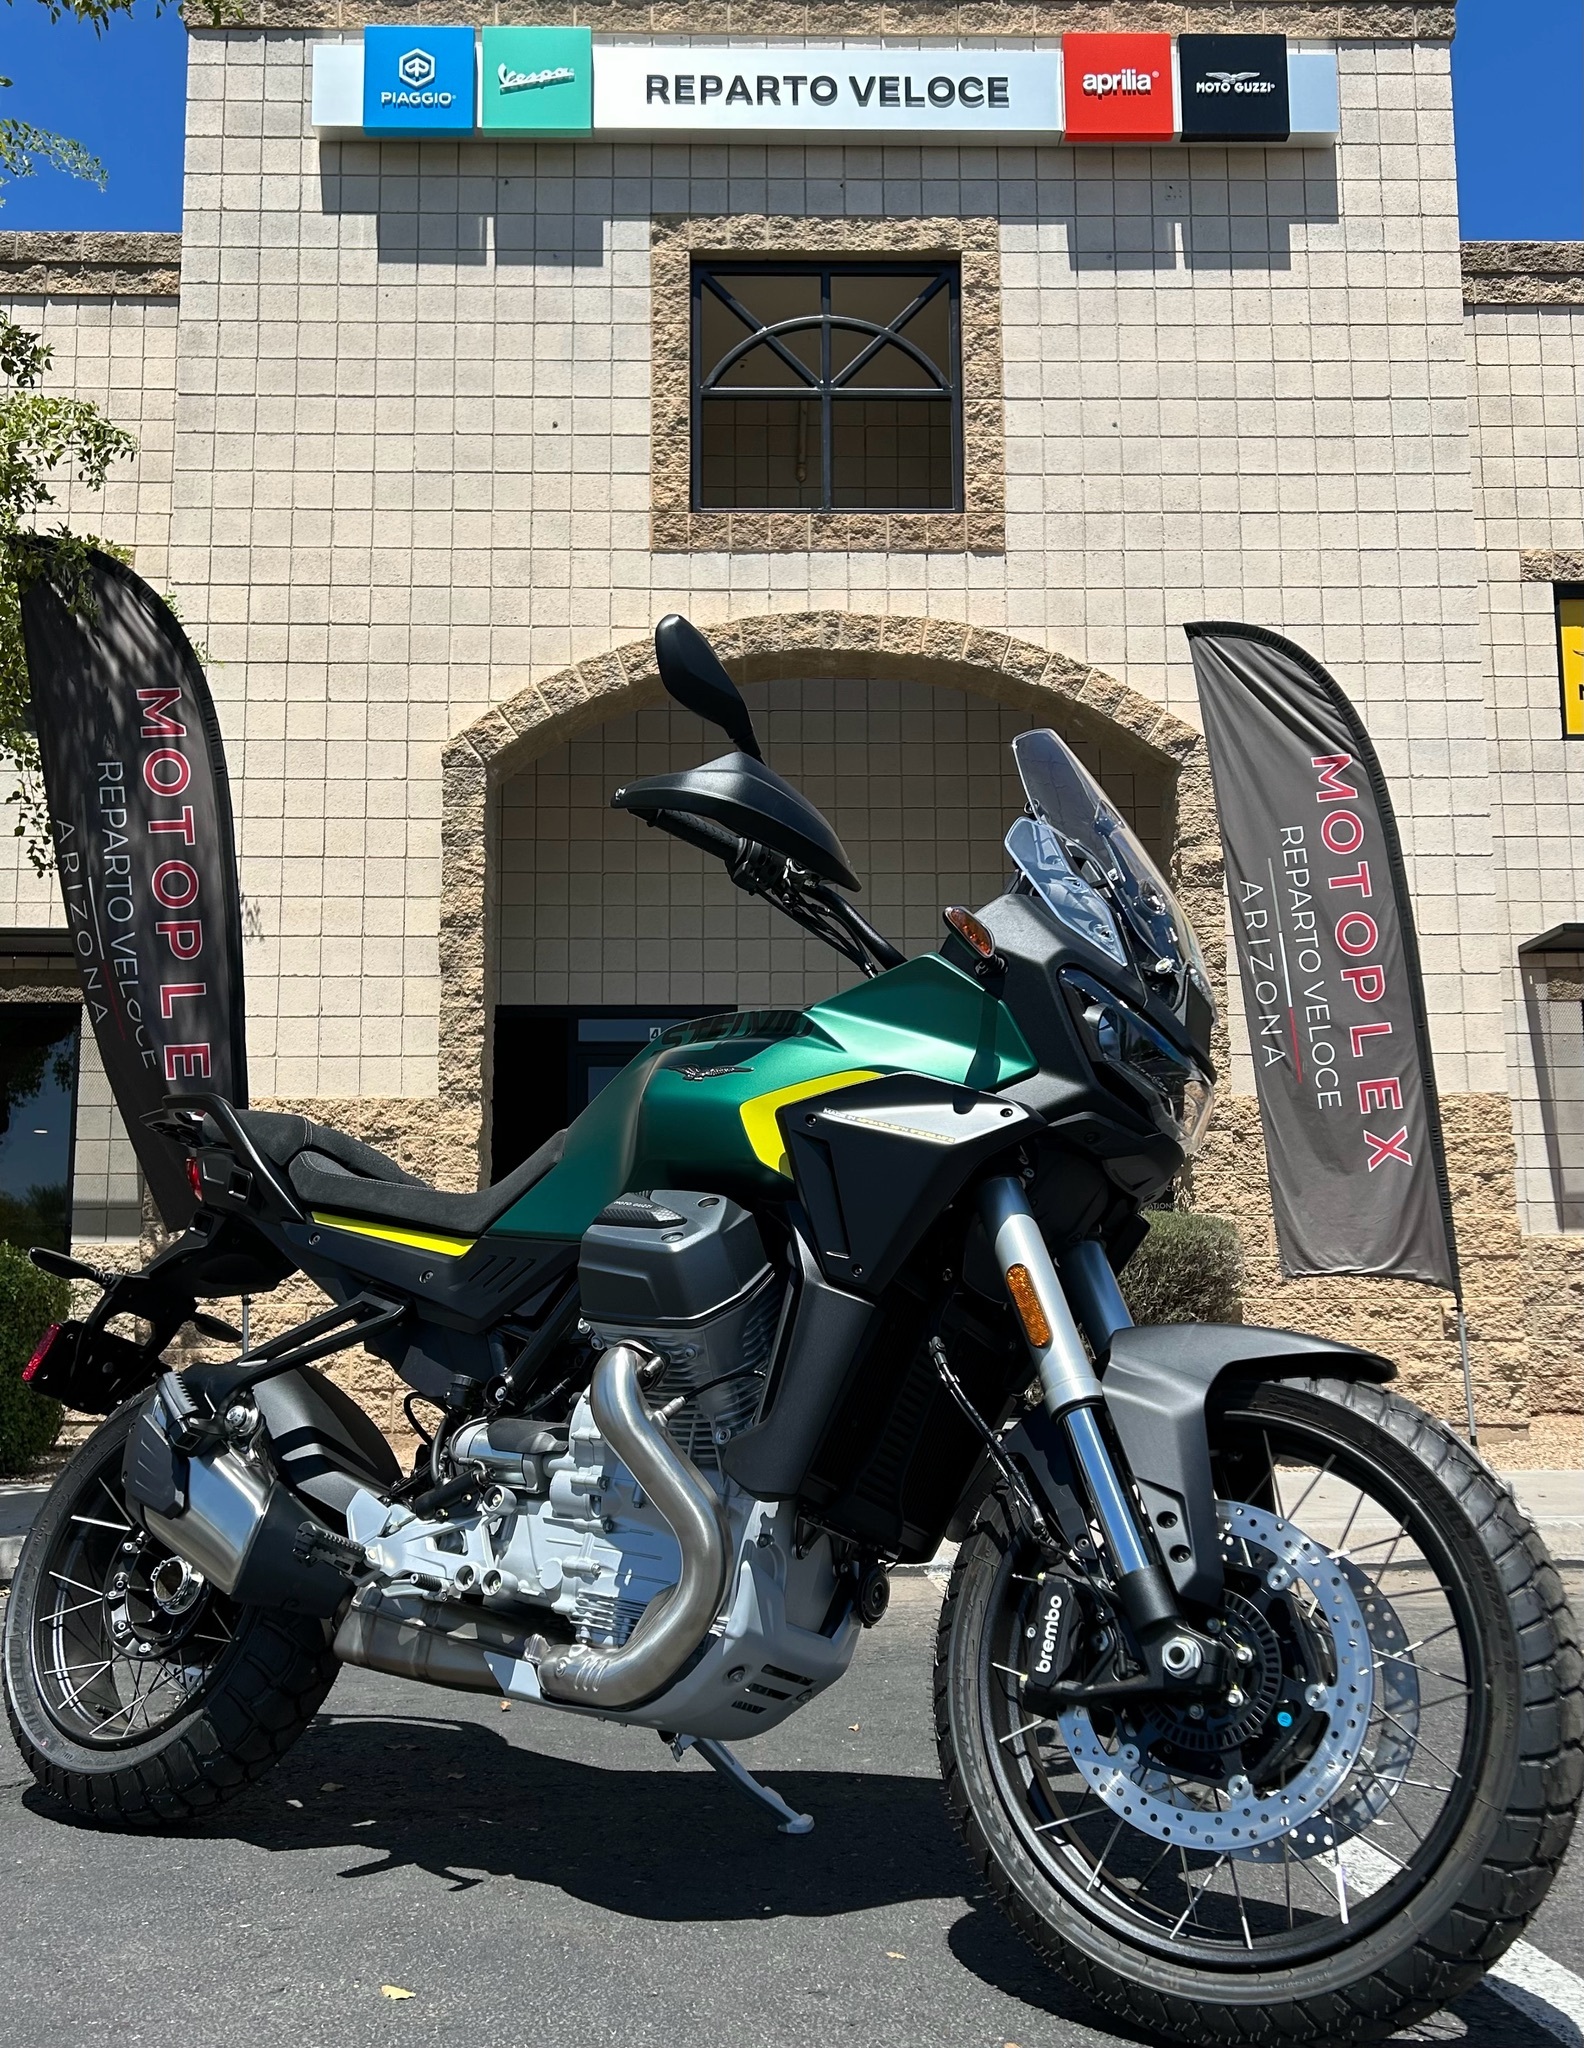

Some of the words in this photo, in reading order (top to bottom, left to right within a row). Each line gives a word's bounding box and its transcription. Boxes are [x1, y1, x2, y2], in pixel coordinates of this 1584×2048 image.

[381, 91, 452, 105] PIAGGIO
[498, 63, 575, 89] Vespa
[646, 75, 838, 105] REPARTO
[848, 76, 1010, 107] VELOCE
[1082, 69, 1151, 95] aprilia
[1196, 82, 1230, 93] MOTO
[1234, 82, 1271, 93] GUZZI
[97, 761, 135, 923] REPARTO
[56, 819, 106, 1024] ARIZONA
[136, 686, 213, 1120] MOTOPLE
[1310, 752, 1413, 1173] MOTOPLEX
[1239, 879, 1286, 1068] ARIZONA
[1279, 825, 1319, 974] REPARTO
[1301, 981, 1342, 1110] VELOCE
[1035, 1595, 1062, 1673] brembo
